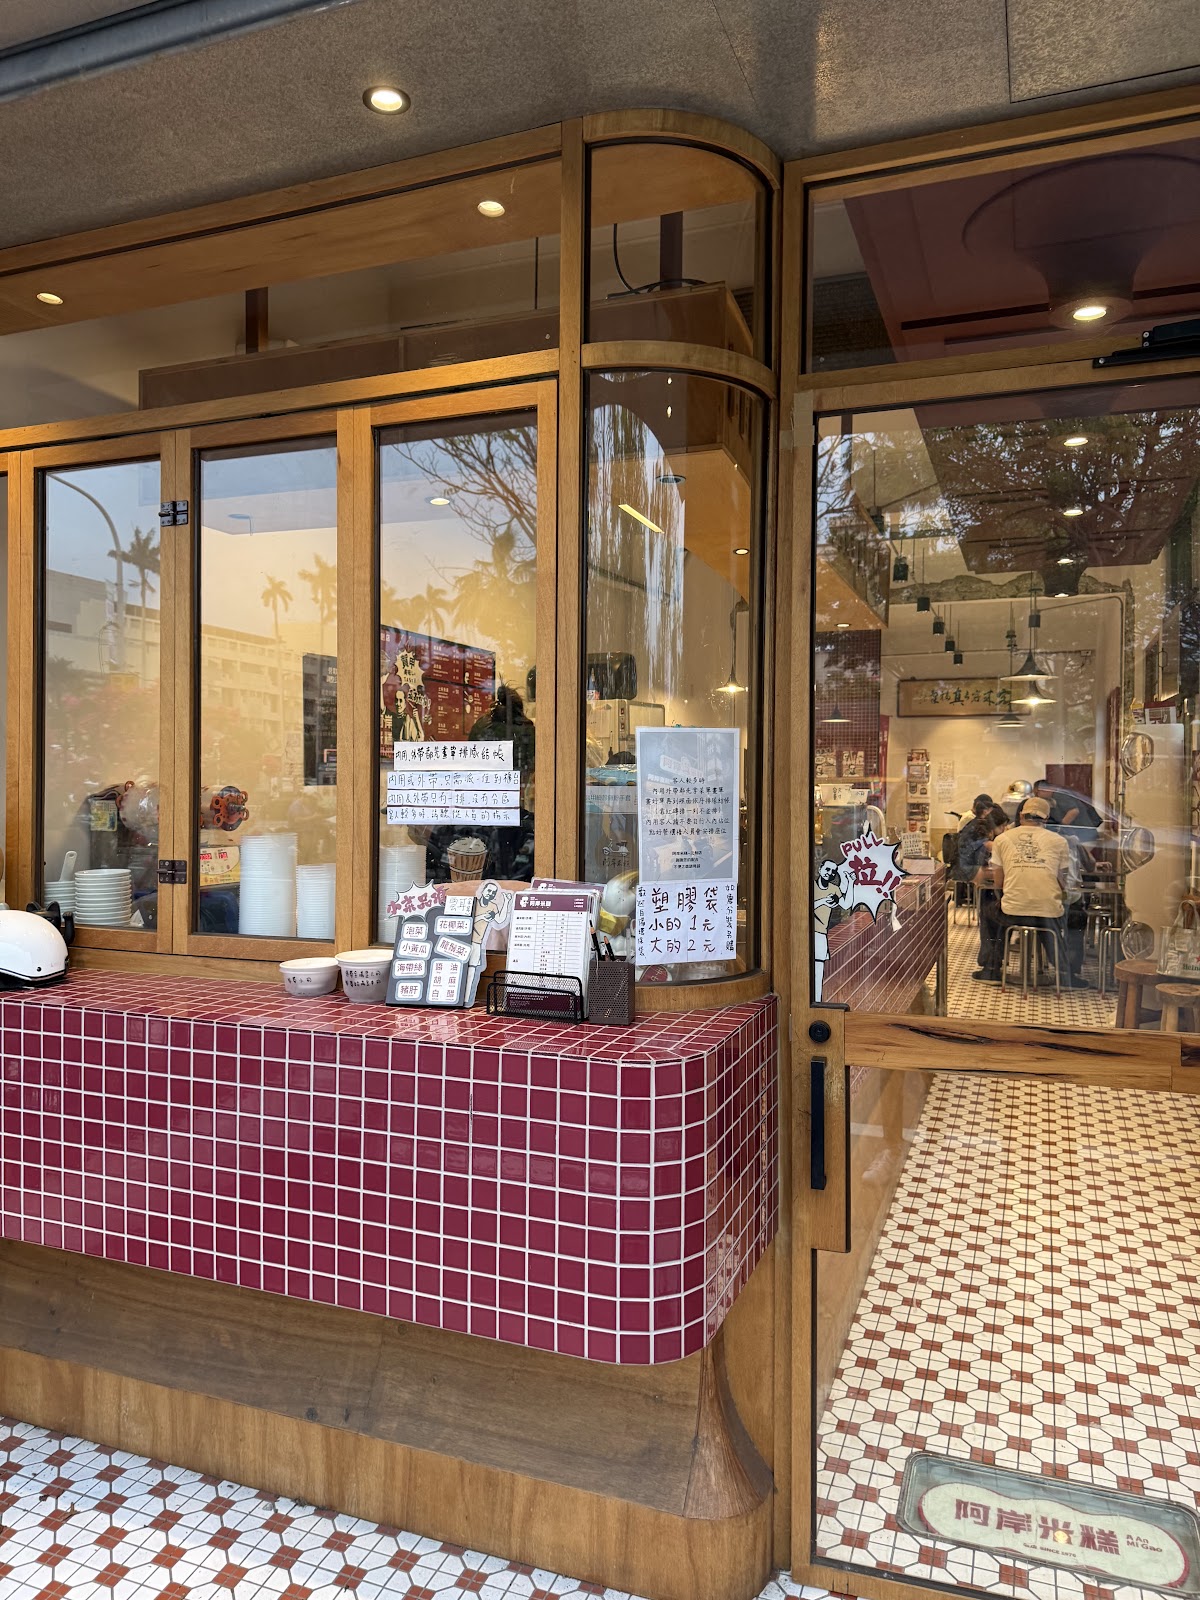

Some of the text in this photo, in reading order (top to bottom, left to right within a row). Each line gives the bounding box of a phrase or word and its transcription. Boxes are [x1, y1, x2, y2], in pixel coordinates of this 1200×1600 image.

[673, 777, 705, 785] 客人較多時
[842, 833, 884, 857] PULL
[848, 855, 901, 898] 拉!!
[652, 886, 718, 914] 塑膠袋
[406, 926, 423, 936] 泡菜
[402, 943, 427, 954] 小黃瓜
[397, 962, 423, 972] 海帶絲
[400, 985, 419, 995] 豬肝
[955, 1498, 1120, 1555] 阿岸米糕
[1039, 1546, 1061, 1555] SINCE
